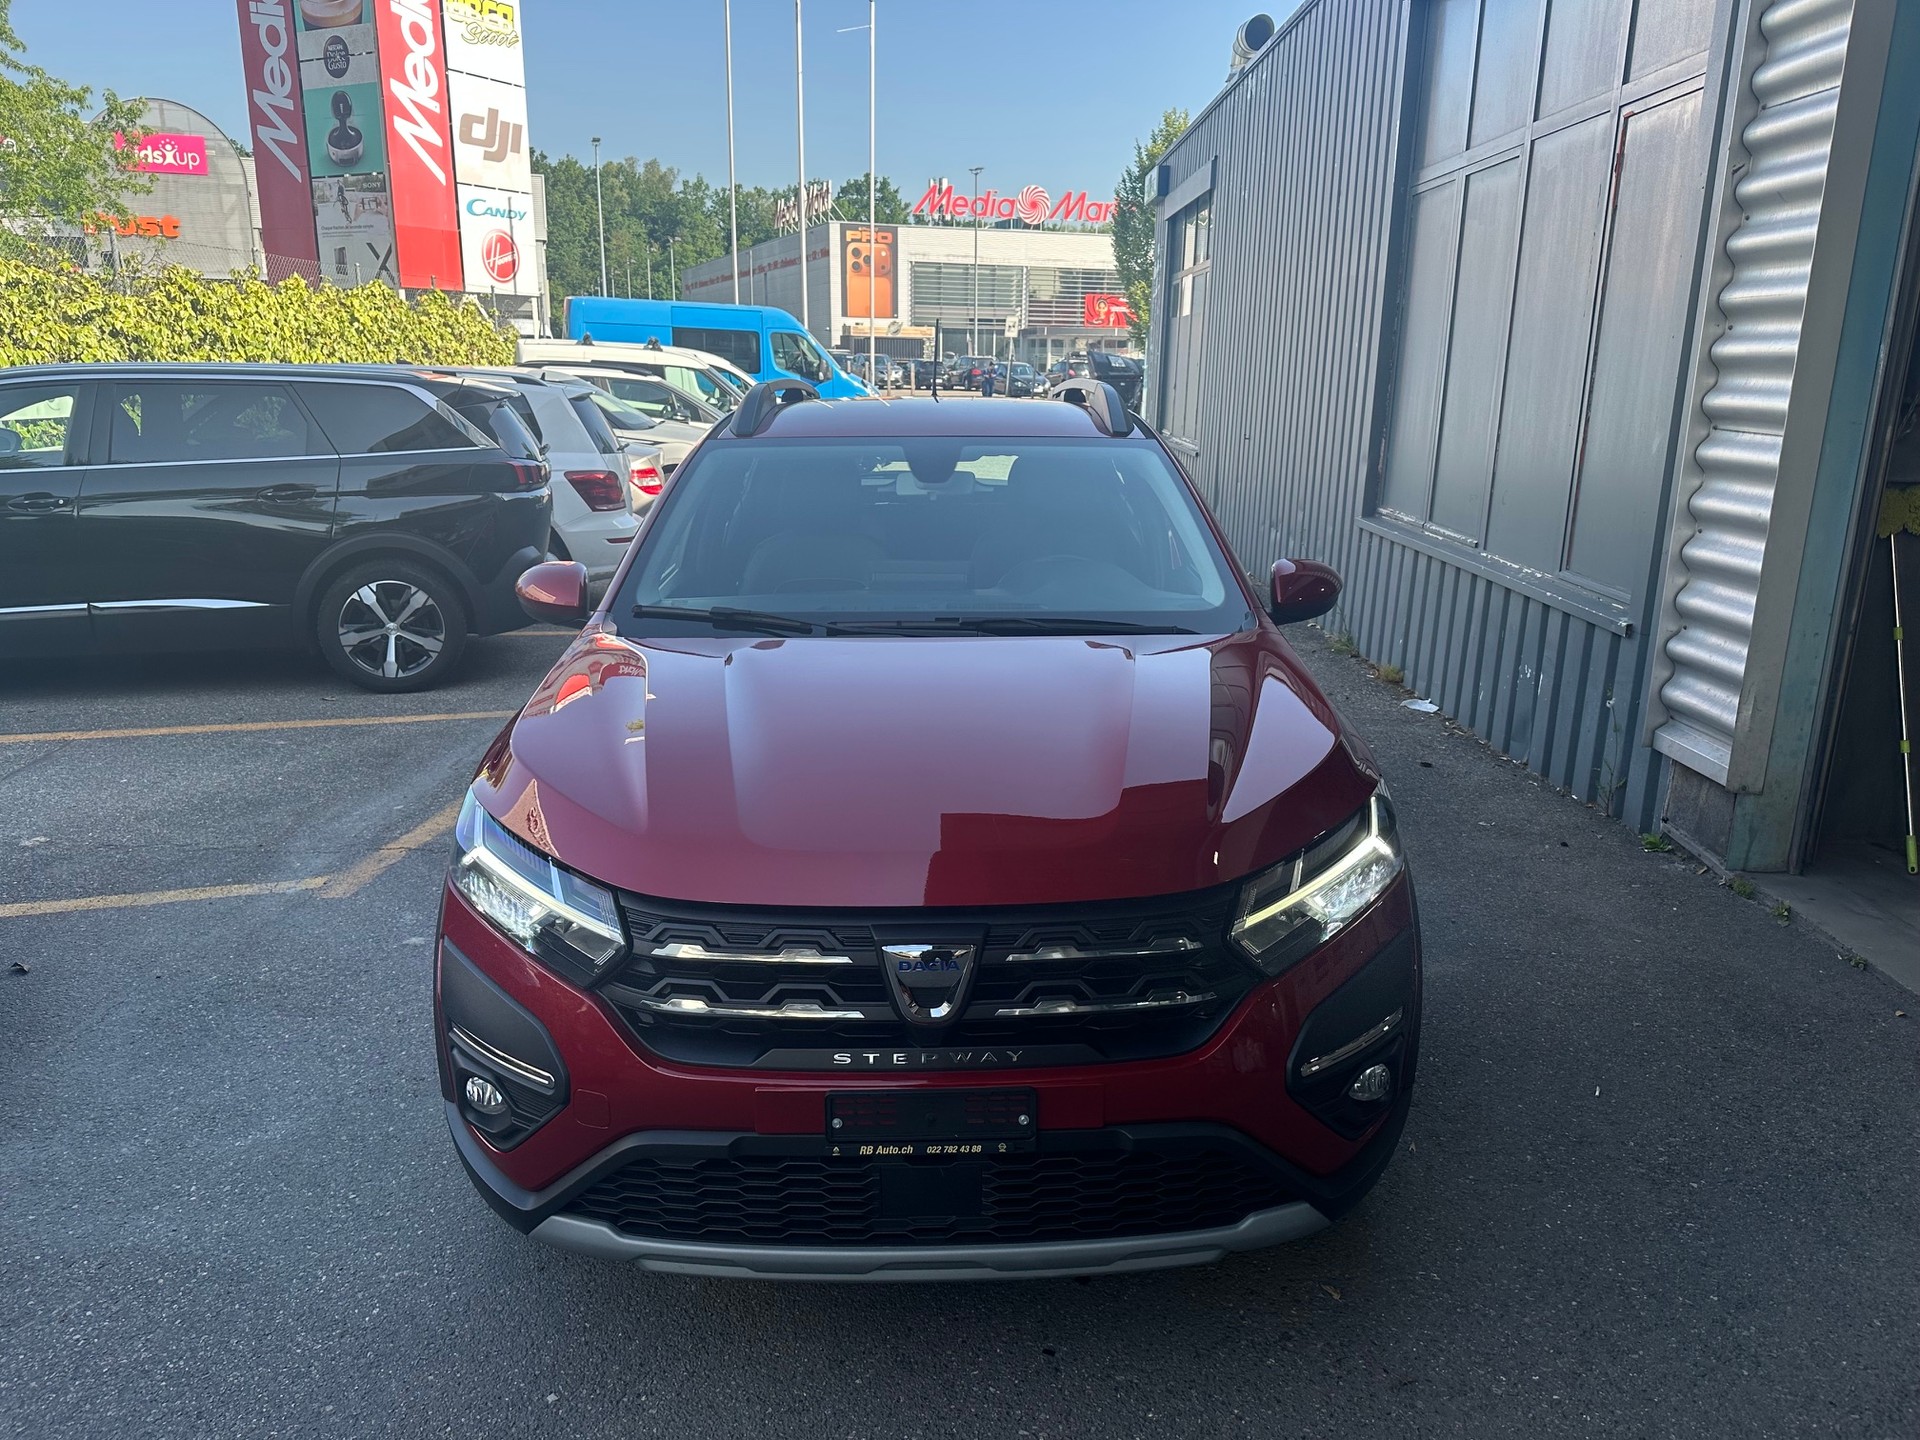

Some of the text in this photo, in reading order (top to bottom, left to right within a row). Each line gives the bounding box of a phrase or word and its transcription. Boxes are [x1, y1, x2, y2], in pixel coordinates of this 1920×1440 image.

[461, 21, 520, 48] Scoot
[249, 0, 302, 184] Medi
[389, 0, 446, 186] Medi
[122, 142, 164, 164] ids
[912, 184, 1119, 222] Media Mar
[846, 230, 893, 244] PRO
[898, 960, 960, 972] DACIA
[833, 1051, 1023, 1065] STEPWAY
[860, 1145, 874, 1155] RB
[876, 1144, 914, 1155] Auto.ch
[926, 1145, 942, 1154] 022
[943, 1145, 958, 1153] 782
[959, 1144, 970, 1153] 43
